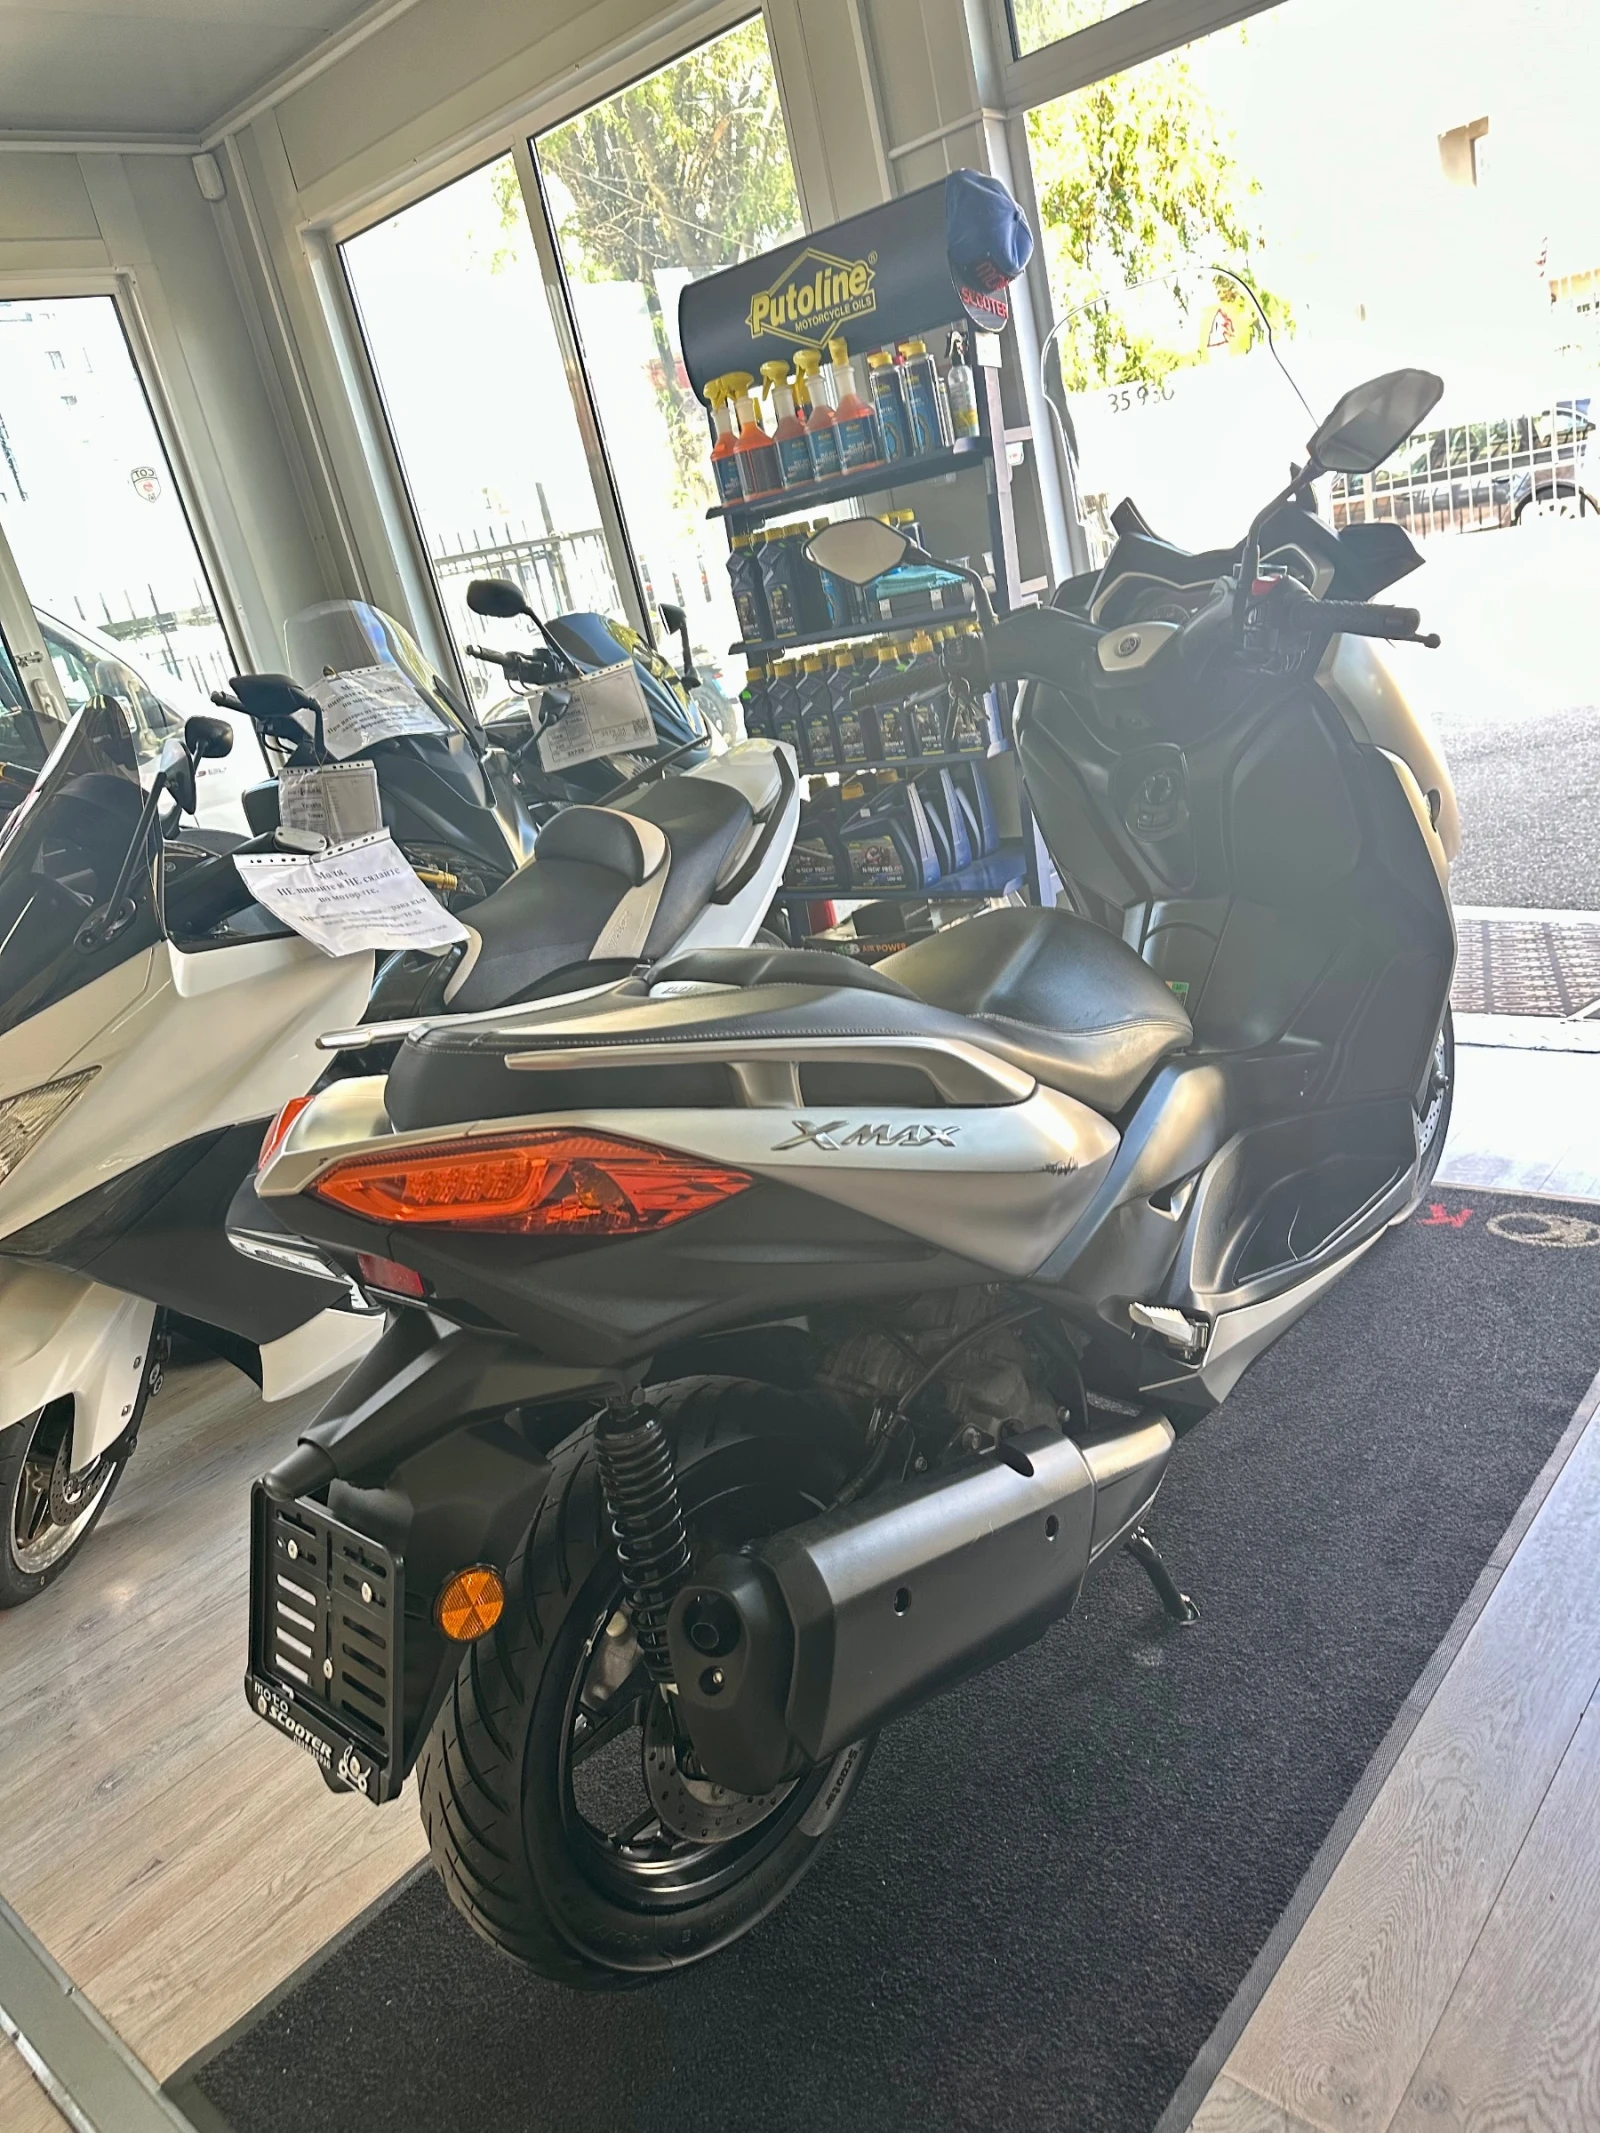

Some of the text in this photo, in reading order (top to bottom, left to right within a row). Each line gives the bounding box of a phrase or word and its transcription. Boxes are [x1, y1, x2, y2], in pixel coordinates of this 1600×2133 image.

[752, 264, 867, 335] Putoline
[795, 296, 872, 333] MOTORCYCLE OILS
[961, 286, 1009, 320] SCOOTER
[268, 1705, 333, 1760] SCOOTER
